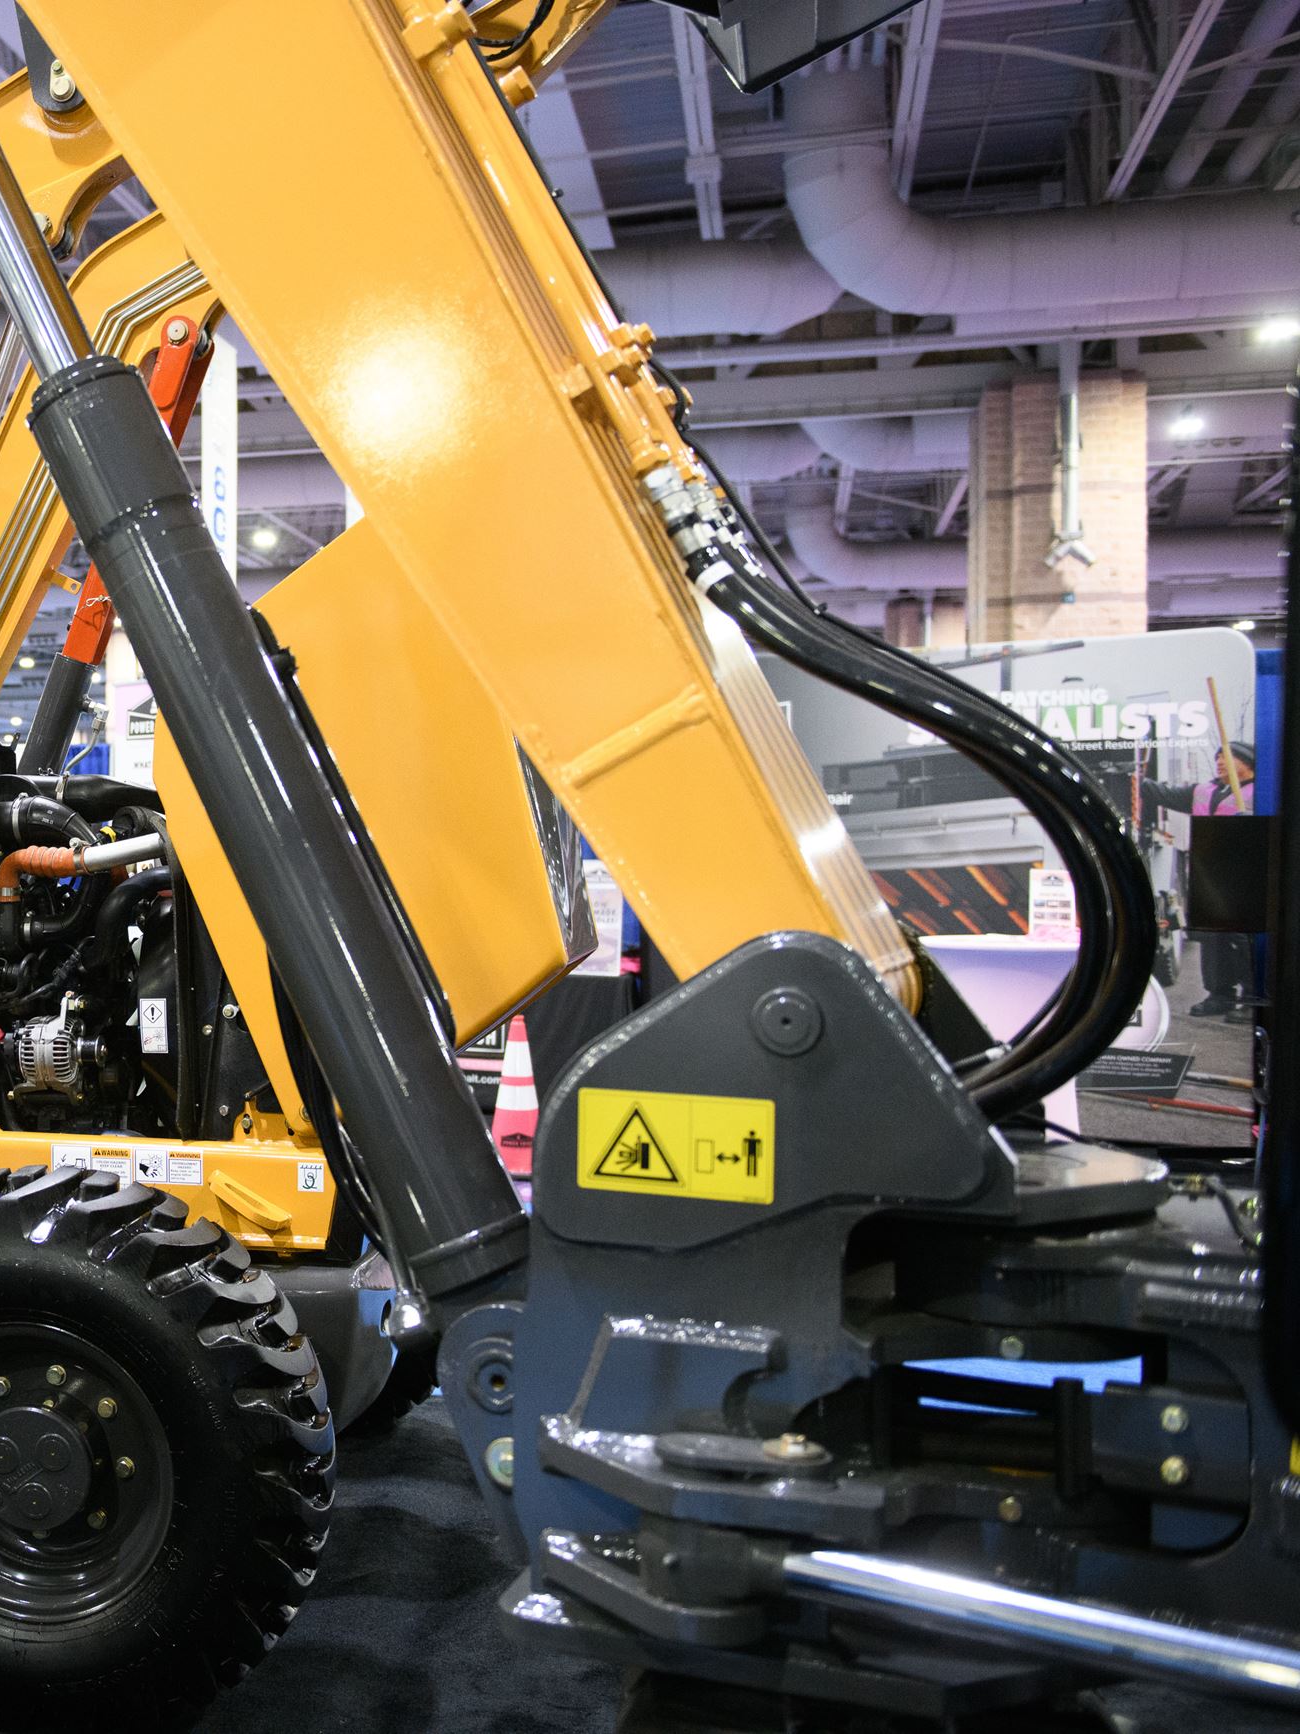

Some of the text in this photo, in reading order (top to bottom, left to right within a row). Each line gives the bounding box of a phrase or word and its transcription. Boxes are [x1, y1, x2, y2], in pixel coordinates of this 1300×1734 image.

[1000, 688, 1109, 706] PATCHING
[1071, 741, 1101, 750] Street
[1104, 739, 1158, 750] Restoration
[1160, 738, 1208, 749] Experts
[100, 1150, 129, 1158] WARNING
